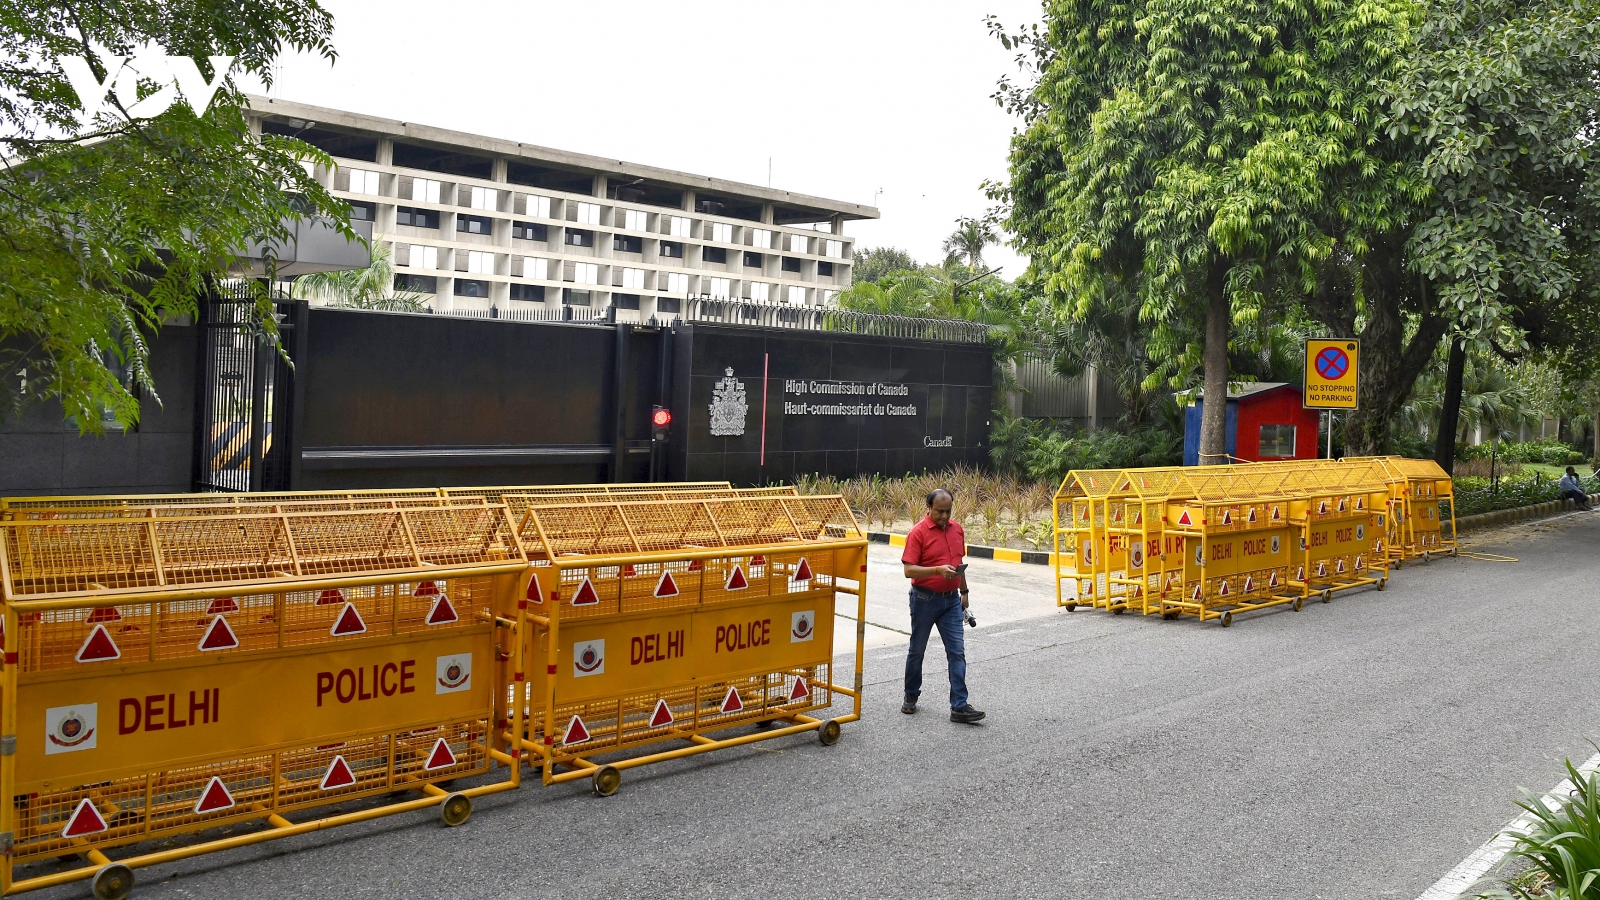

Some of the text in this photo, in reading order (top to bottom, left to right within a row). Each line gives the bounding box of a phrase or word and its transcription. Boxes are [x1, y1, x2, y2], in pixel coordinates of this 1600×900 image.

[785, 380, 909, 396] High Commission of Canada
[784, 402, 917, 416] Haut-commissariat du Canada
[923, 435, 952, 448] Canada
[1311, 527, 1352, 547] DELHI POLICE
[1212, 538, 1266, 560] DELHI POLICE
[630, 618, 771, 666] DELHI POLICE
[118, 659, 416, 735] DELHI POLICE
